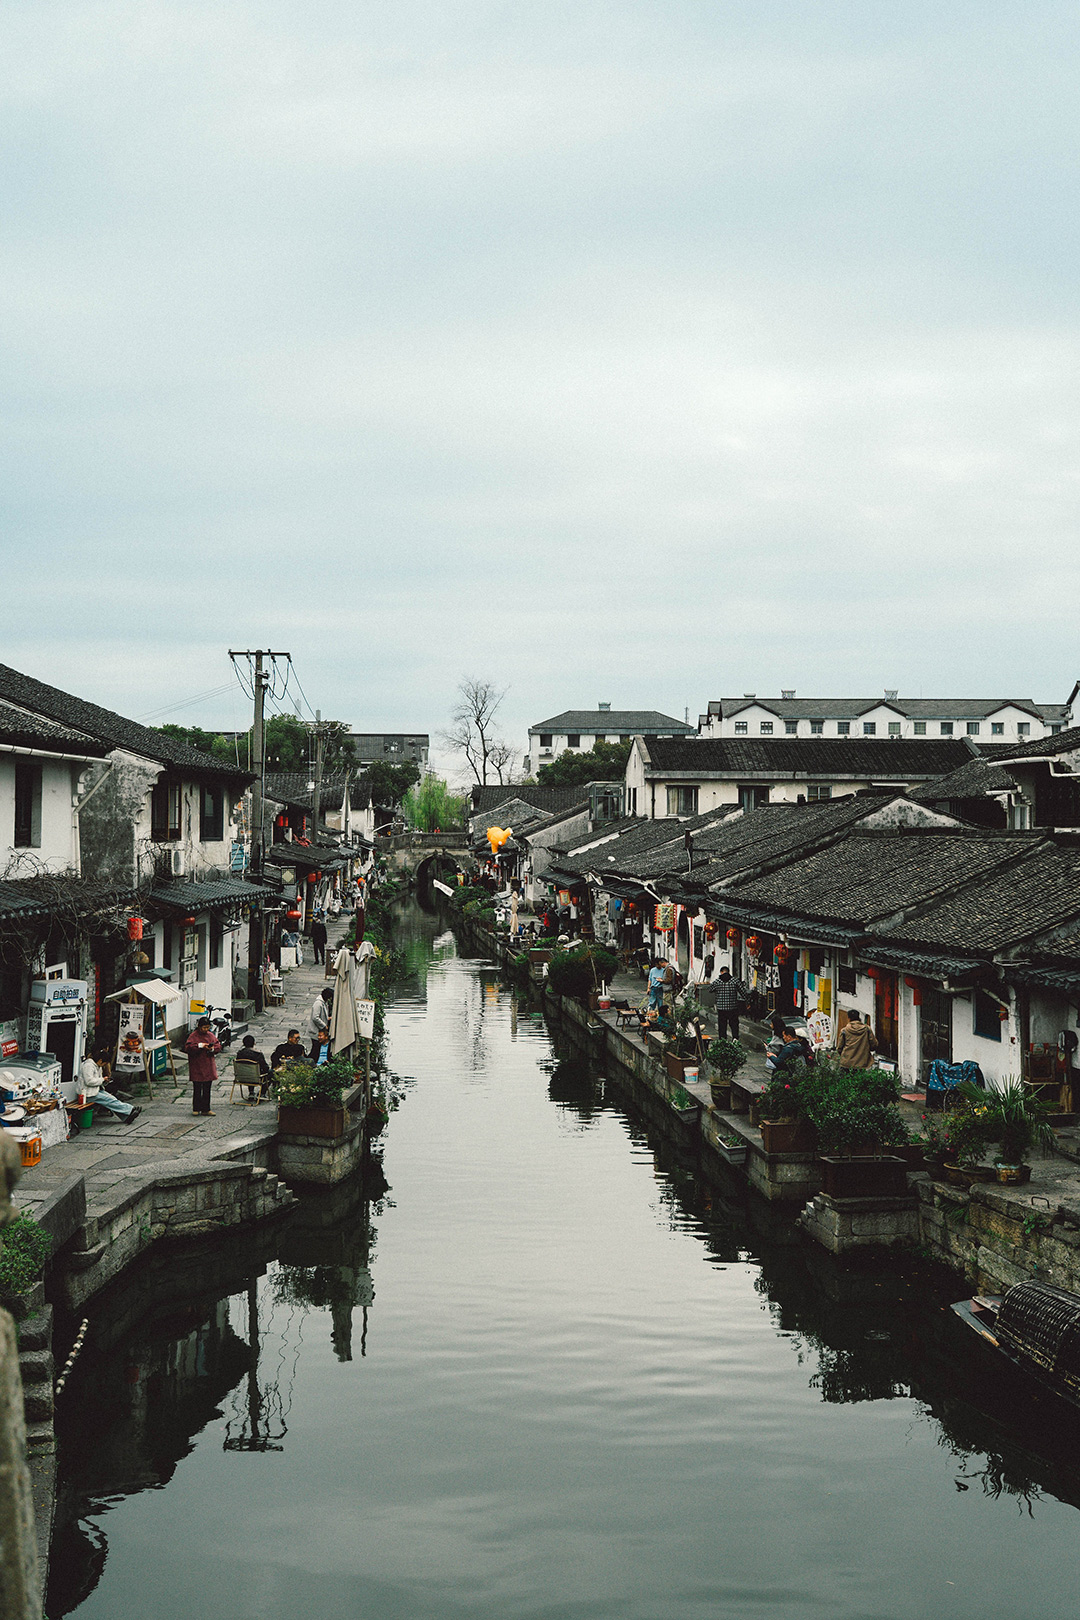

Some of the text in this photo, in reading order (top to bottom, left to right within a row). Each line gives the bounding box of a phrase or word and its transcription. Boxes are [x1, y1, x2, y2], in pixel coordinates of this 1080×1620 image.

[53, 988, 79, 999] 自助拍照
[29, 1007, 42, 1020] 即拍
[121, 1010, 131, 1028] 围炉
[28, 1020, 42, 1033] 即得
[28, 1033, 41, 1043] Snap
[27, 1042, 33, 1050] &
[33, 1043, 41, 1051] Go
[123, 1055, 141, 1064] 煮茶
